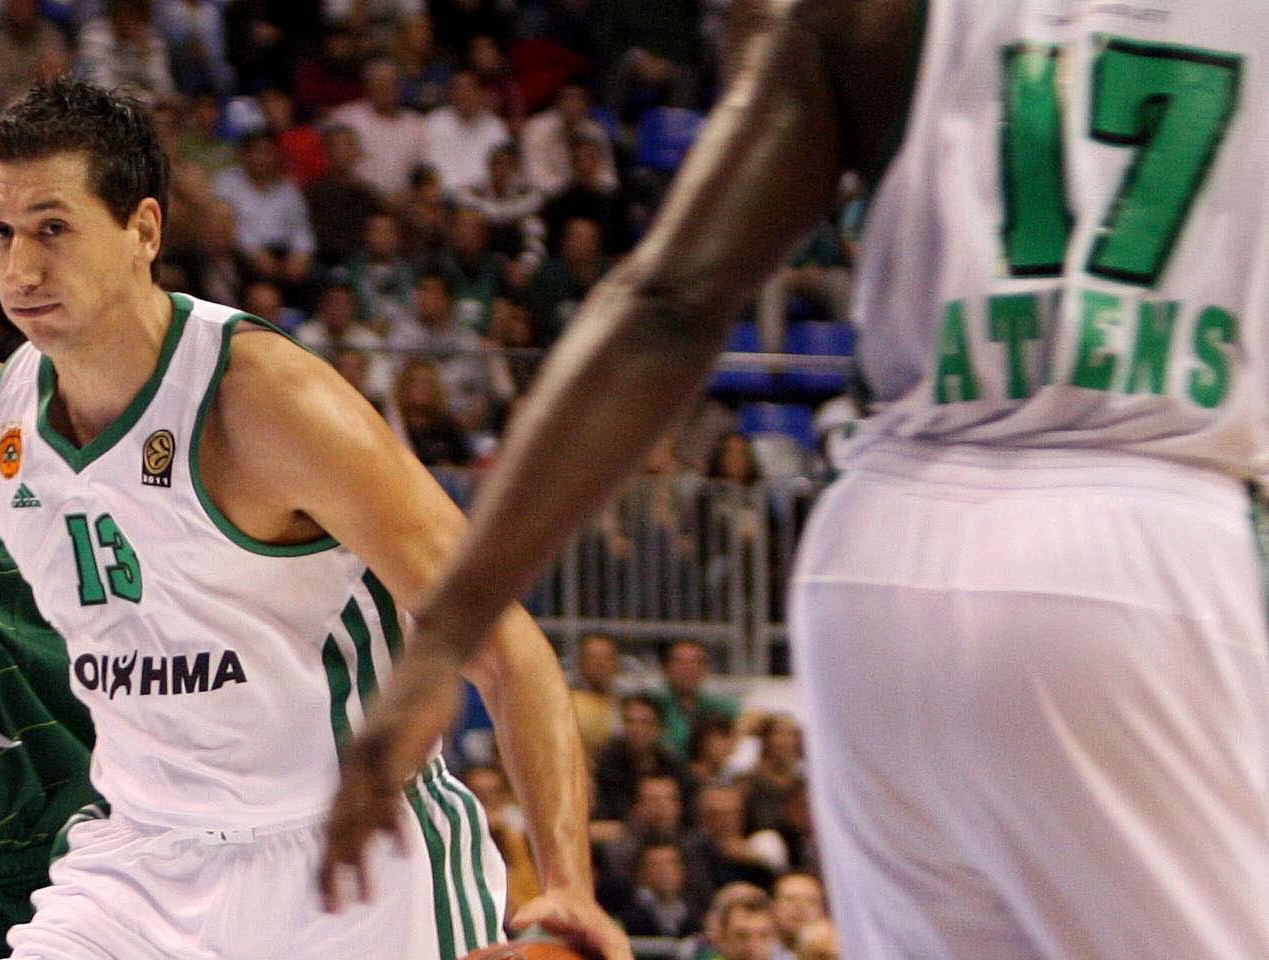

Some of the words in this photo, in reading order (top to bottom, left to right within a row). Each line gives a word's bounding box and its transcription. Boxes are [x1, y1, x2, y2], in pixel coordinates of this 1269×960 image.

[997, 33, 1245, 288] 17
[933, 286, 1240, 410] ATENS
[65, 512, 144, 607] 13
